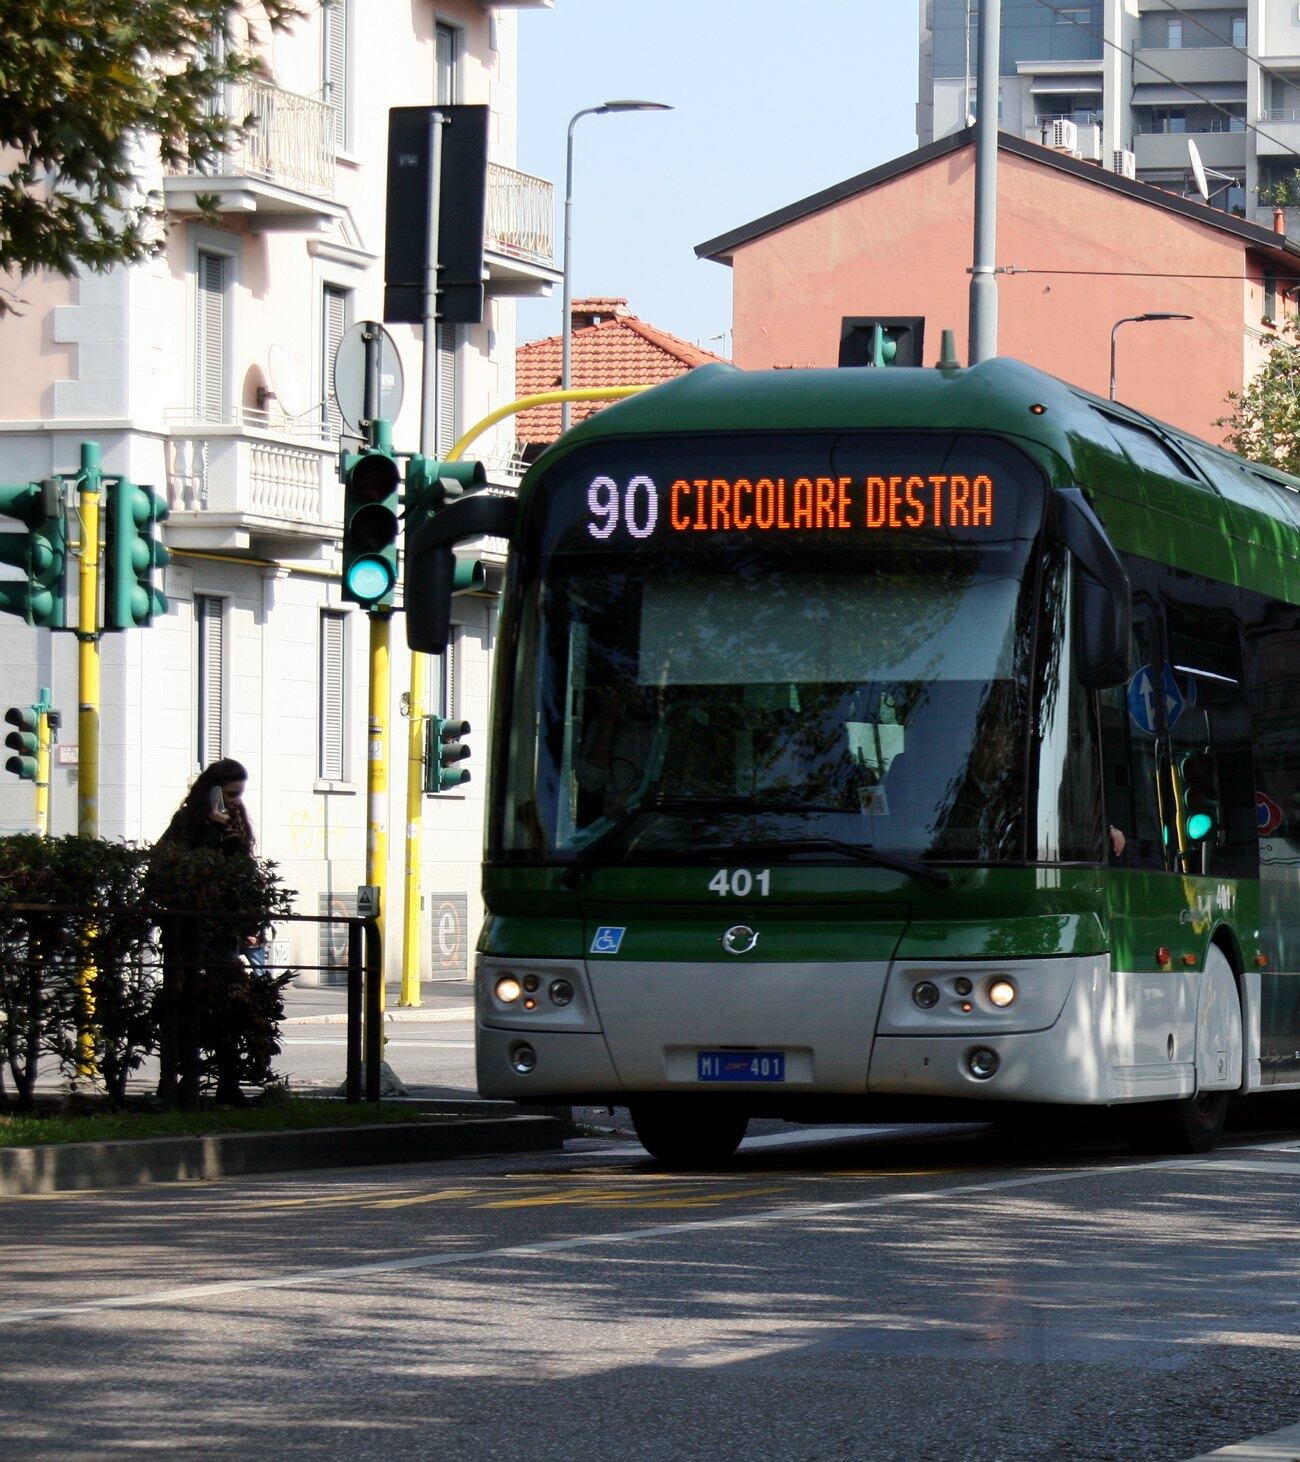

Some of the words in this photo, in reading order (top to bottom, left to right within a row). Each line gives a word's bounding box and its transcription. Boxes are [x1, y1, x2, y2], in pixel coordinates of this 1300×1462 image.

[588, 475, 658, 539] 90
[671, 478, 851, 530] CIRCOLARE
[867, 475, 992, 528] DESTRA
[708, 868, 771, 897] 401
[1216, 884, 1232, 910] 401
[702, 1057, 720, 1076] MI
[750, 1057, 779, 1076] 401
